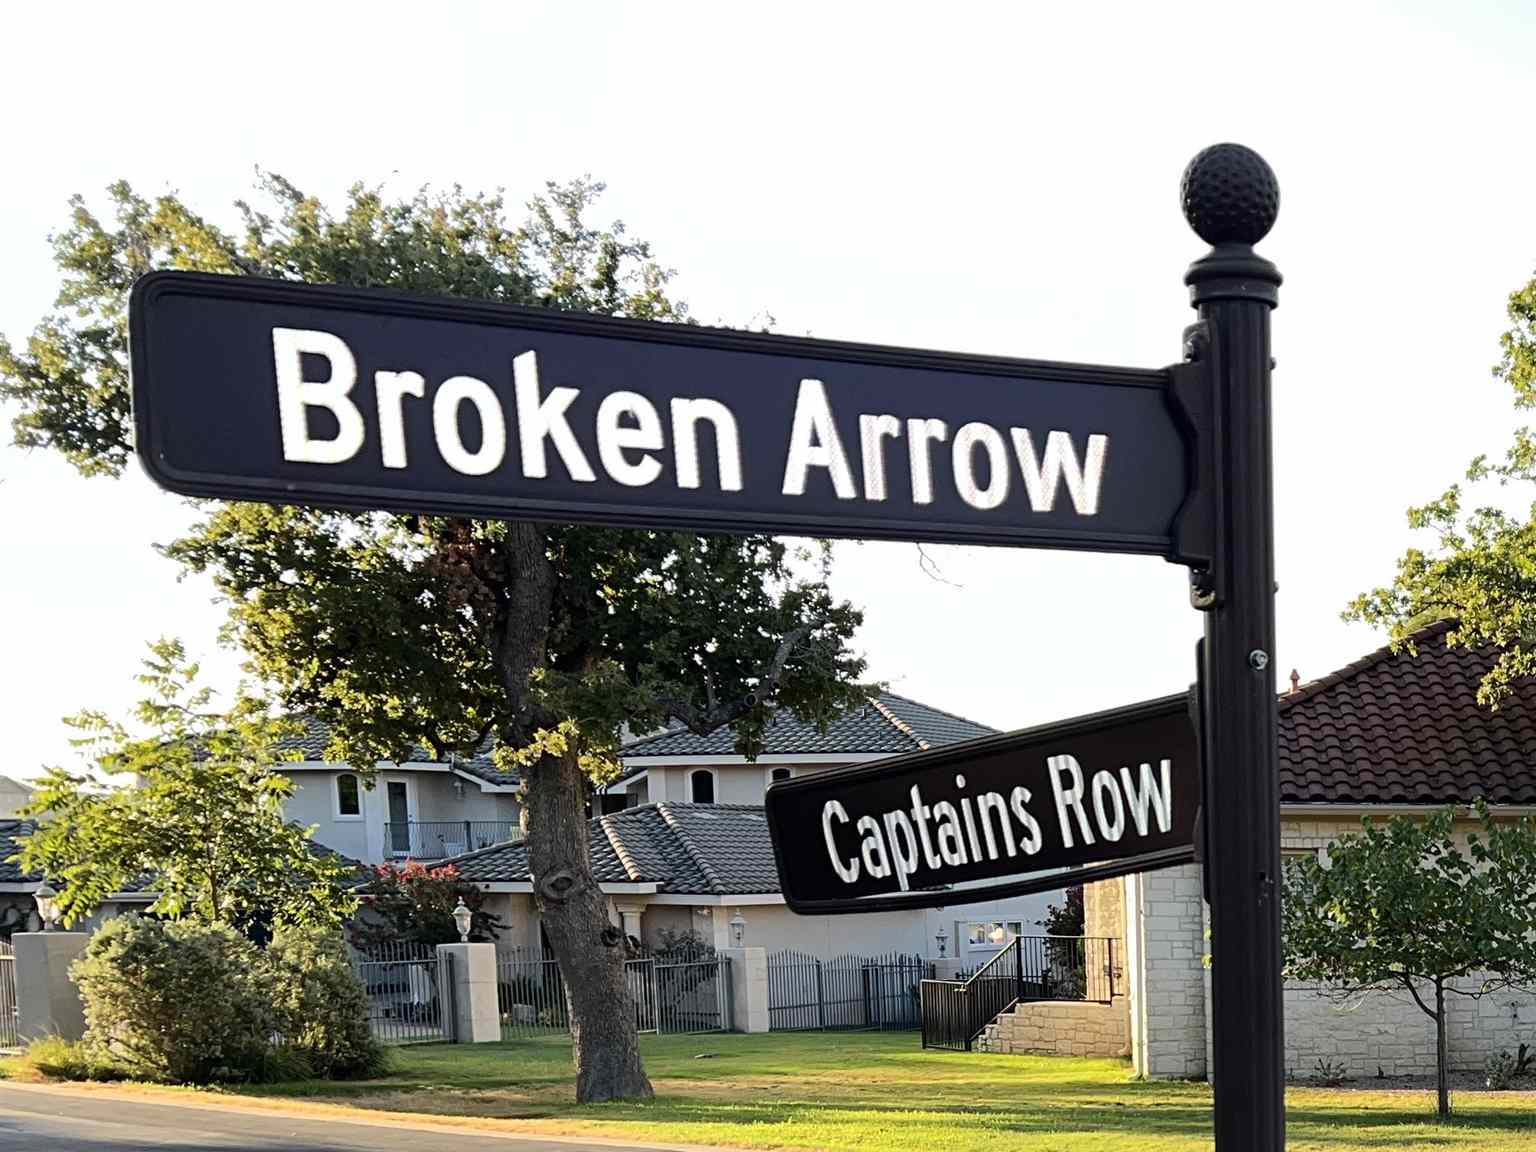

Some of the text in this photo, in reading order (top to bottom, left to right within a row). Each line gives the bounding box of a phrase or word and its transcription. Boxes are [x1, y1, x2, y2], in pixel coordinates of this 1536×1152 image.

[271, 327, 1109, 516] Broken Arrow
[822, 754, 1172, 891] Captains Row
